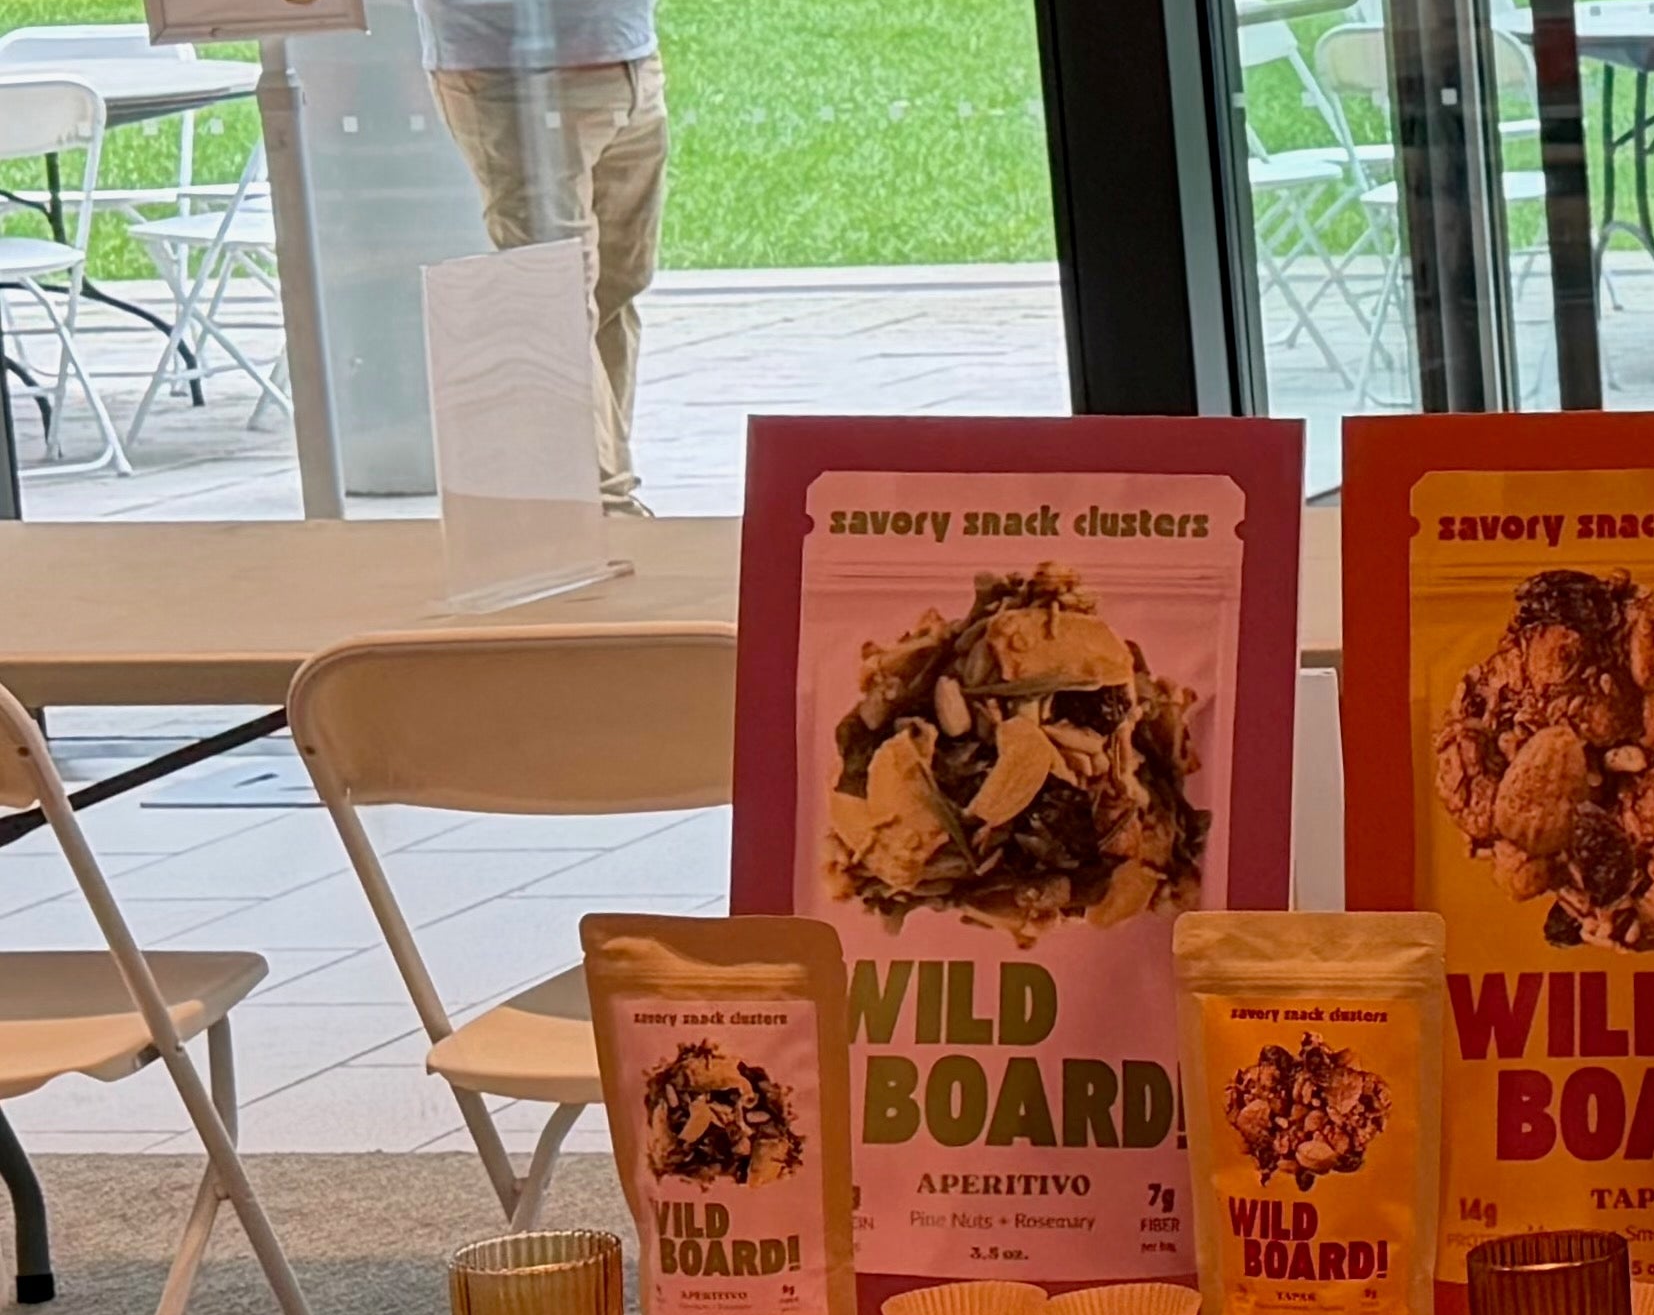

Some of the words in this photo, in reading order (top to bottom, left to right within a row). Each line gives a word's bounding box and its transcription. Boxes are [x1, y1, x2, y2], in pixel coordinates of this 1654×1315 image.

[829, 508, 950, 542] savory
[963, 505, 1060, 537] snack
[1074, 507, 1209, 538] clusters
[1437, 513, 1564, 546] savory
[847, 960, 1057, 1046] WILD
[1231, 1008, 1280, 1023] savory
[1284, 1007, 1324, 1021] snack
[1329, 1007, 1388, 1023] clusters
[862, 1054, 1188, 1150] BOARD!
[916, 1173, 1091, 1197] APERITIVO
[1148, 1183, 1175, 1214] 7g
[910, 1210, 947, 1228] Pine
[951, 1212, 993, 1230] Nuts
[1015, 1212, 1096, 1232] Rosemary
[1140, 1217, 1180, 1233] FIBER
[1228, 1196, 1318, 1242] WILD
[1459, 1197, 1497, 1229] 14g
[659, 1235, 801, 1277] BOARD!
[1243, 1239, 1389, 1282] BOARD!
